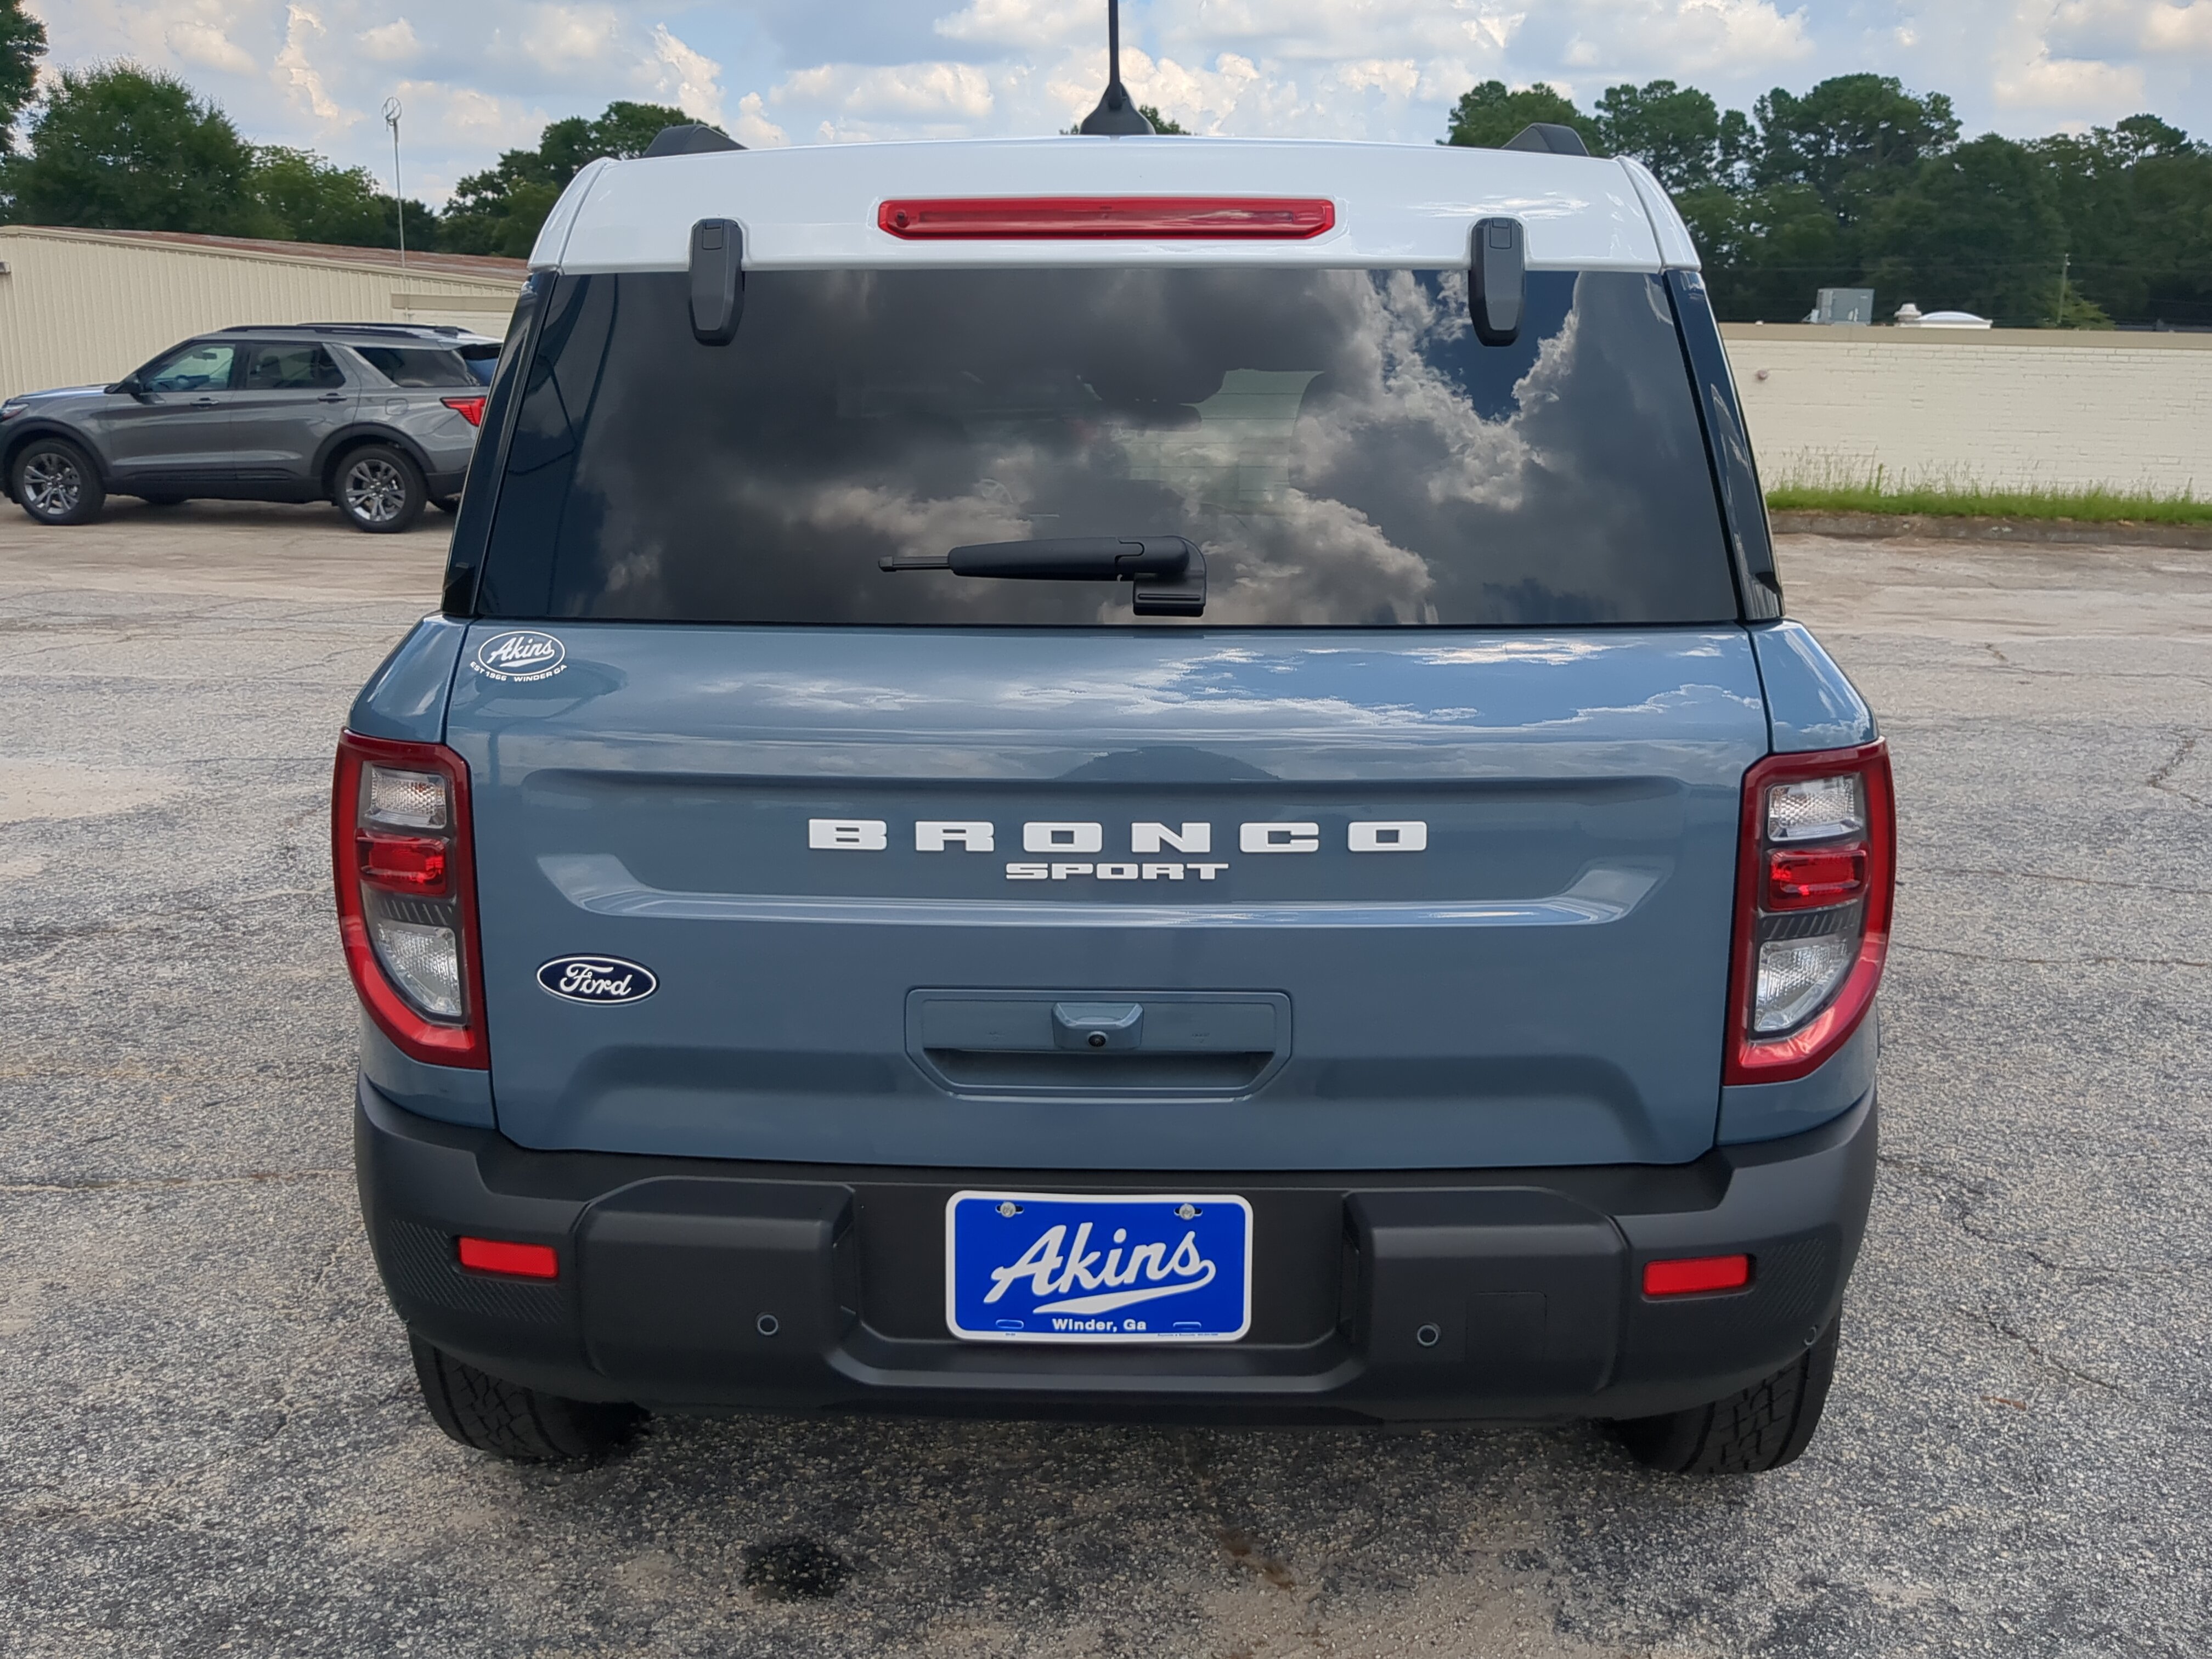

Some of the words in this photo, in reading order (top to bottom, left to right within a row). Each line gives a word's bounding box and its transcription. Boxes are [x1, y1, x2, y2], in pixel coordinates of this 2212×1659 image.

[486, 636, 555, 664] Akins
[470, 661, 485, 674] EST
[486, 671, 507, 681] 1966
[514, 671, 552, 682] WINDER
[554, 664, 567, 674] GA
[809, 819, 1426, 853] BRONCO
[1006, 863, 1229, 880] SPORT
[560, 963, 633, 996] Ford
[984, 1222, 1216, 1304] Akins
[1052, 1318, 1118, 1333] Winder,
[1123, 1319, 1147, 1330] Ga
